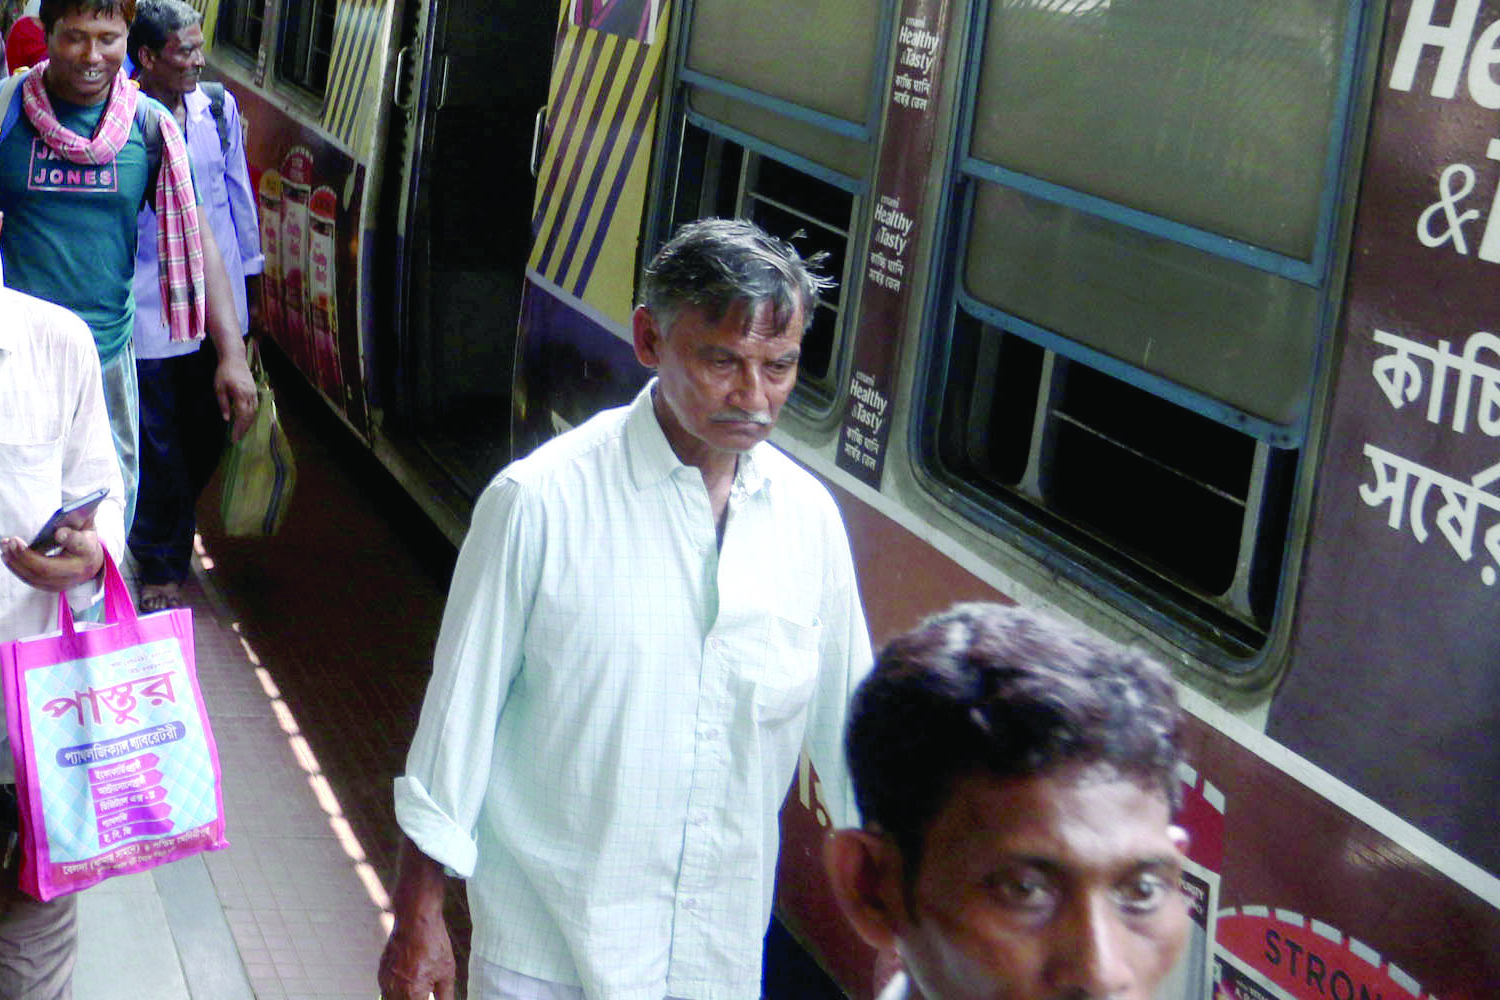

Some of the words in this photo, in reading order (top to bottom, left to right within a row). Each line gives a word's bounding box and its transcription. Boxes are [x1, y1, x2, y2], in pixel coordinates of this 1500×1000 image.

[900, 25, 939, 55] Healthy
[34, 168, 112, 186] JONES
[875, 203, 913, 237] Healthy
[850, 379, 888, 416] Healthy
